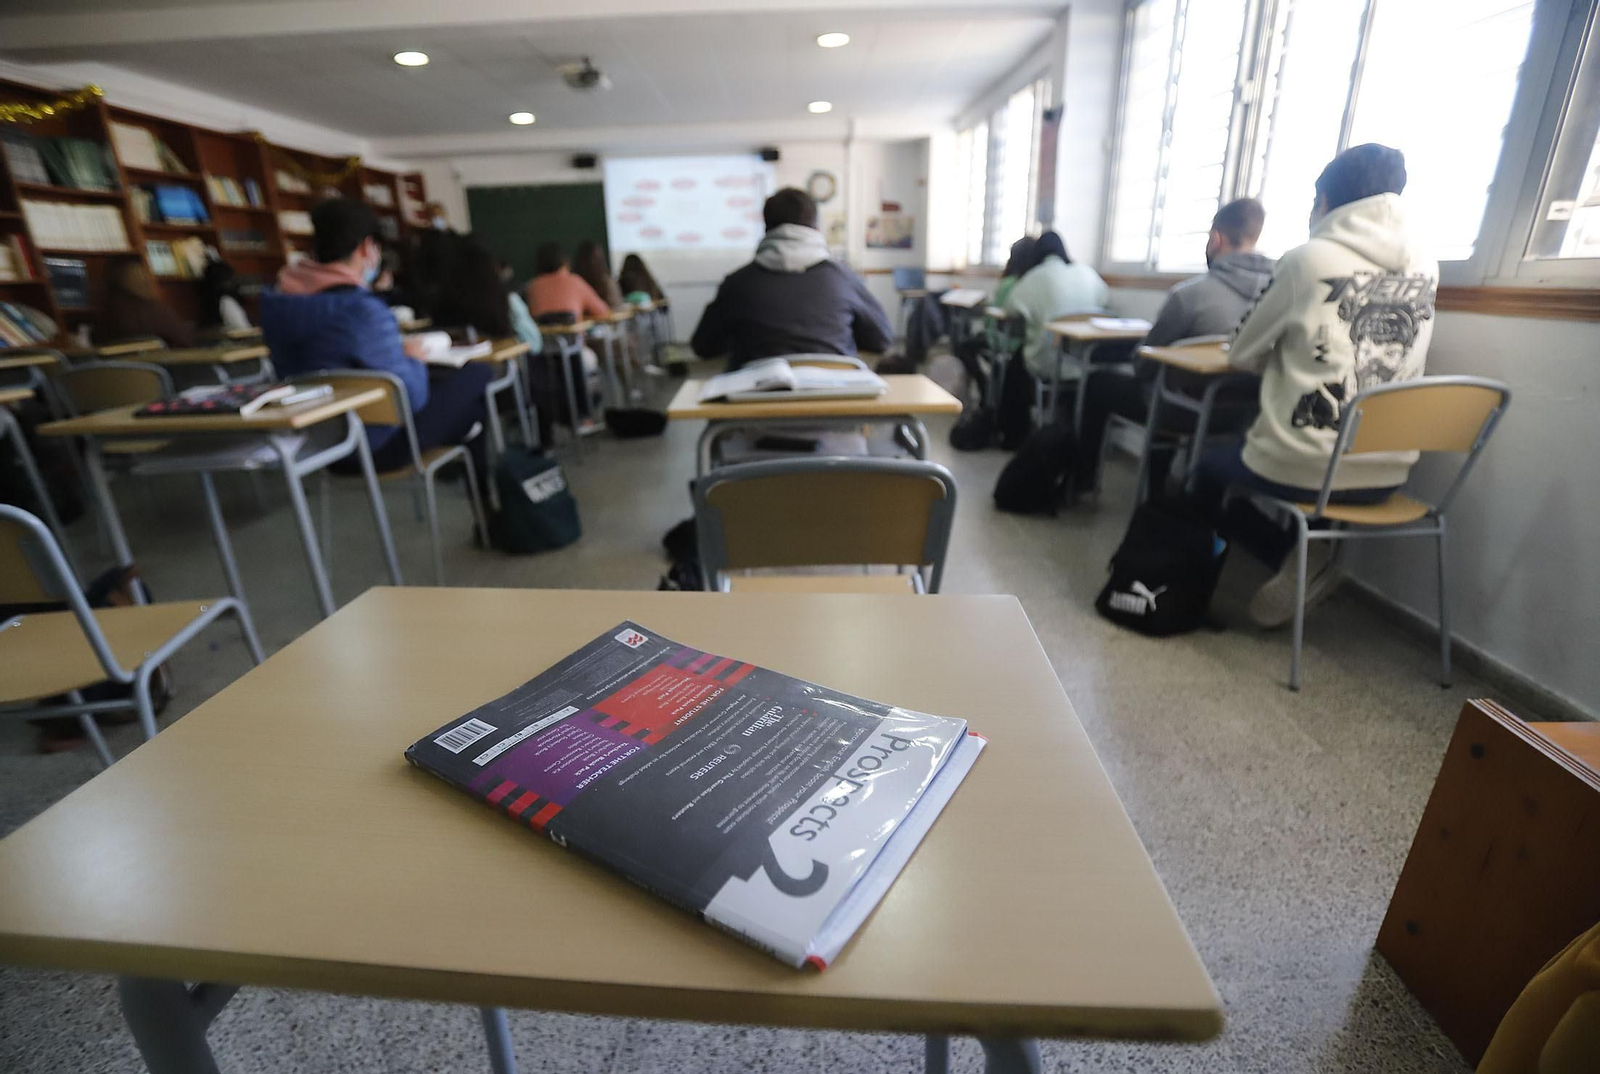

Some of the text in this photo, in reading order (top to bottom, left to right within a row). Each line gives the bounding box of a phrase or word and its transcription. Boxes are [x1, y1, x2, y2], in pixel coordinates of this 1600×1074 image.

[670, 706, 683, 714] Pack
[671, 687, 724, 725] FOR THE STUDENT
[741, 706, 782, 736] Guardian
[762, 714, 783, 727] The
[573, 741, 628, 776] Teacher's Book Pack
[574, 746, 640, 789] FOR THE TEACHER
[689, 754, 726, 780] REUTERS
[699, 779, 726, 797] Guardian
[721, 772, 734, 780] The
[788, 733, 912, 842] Prospects
[803, 772, 824, 787] boost
[791, 785, 810, 799] your
[670, 802, 695, 820] Reuters
[764, 797, 798, 824] Prospects!
[735, 838, 828, 897] 2
